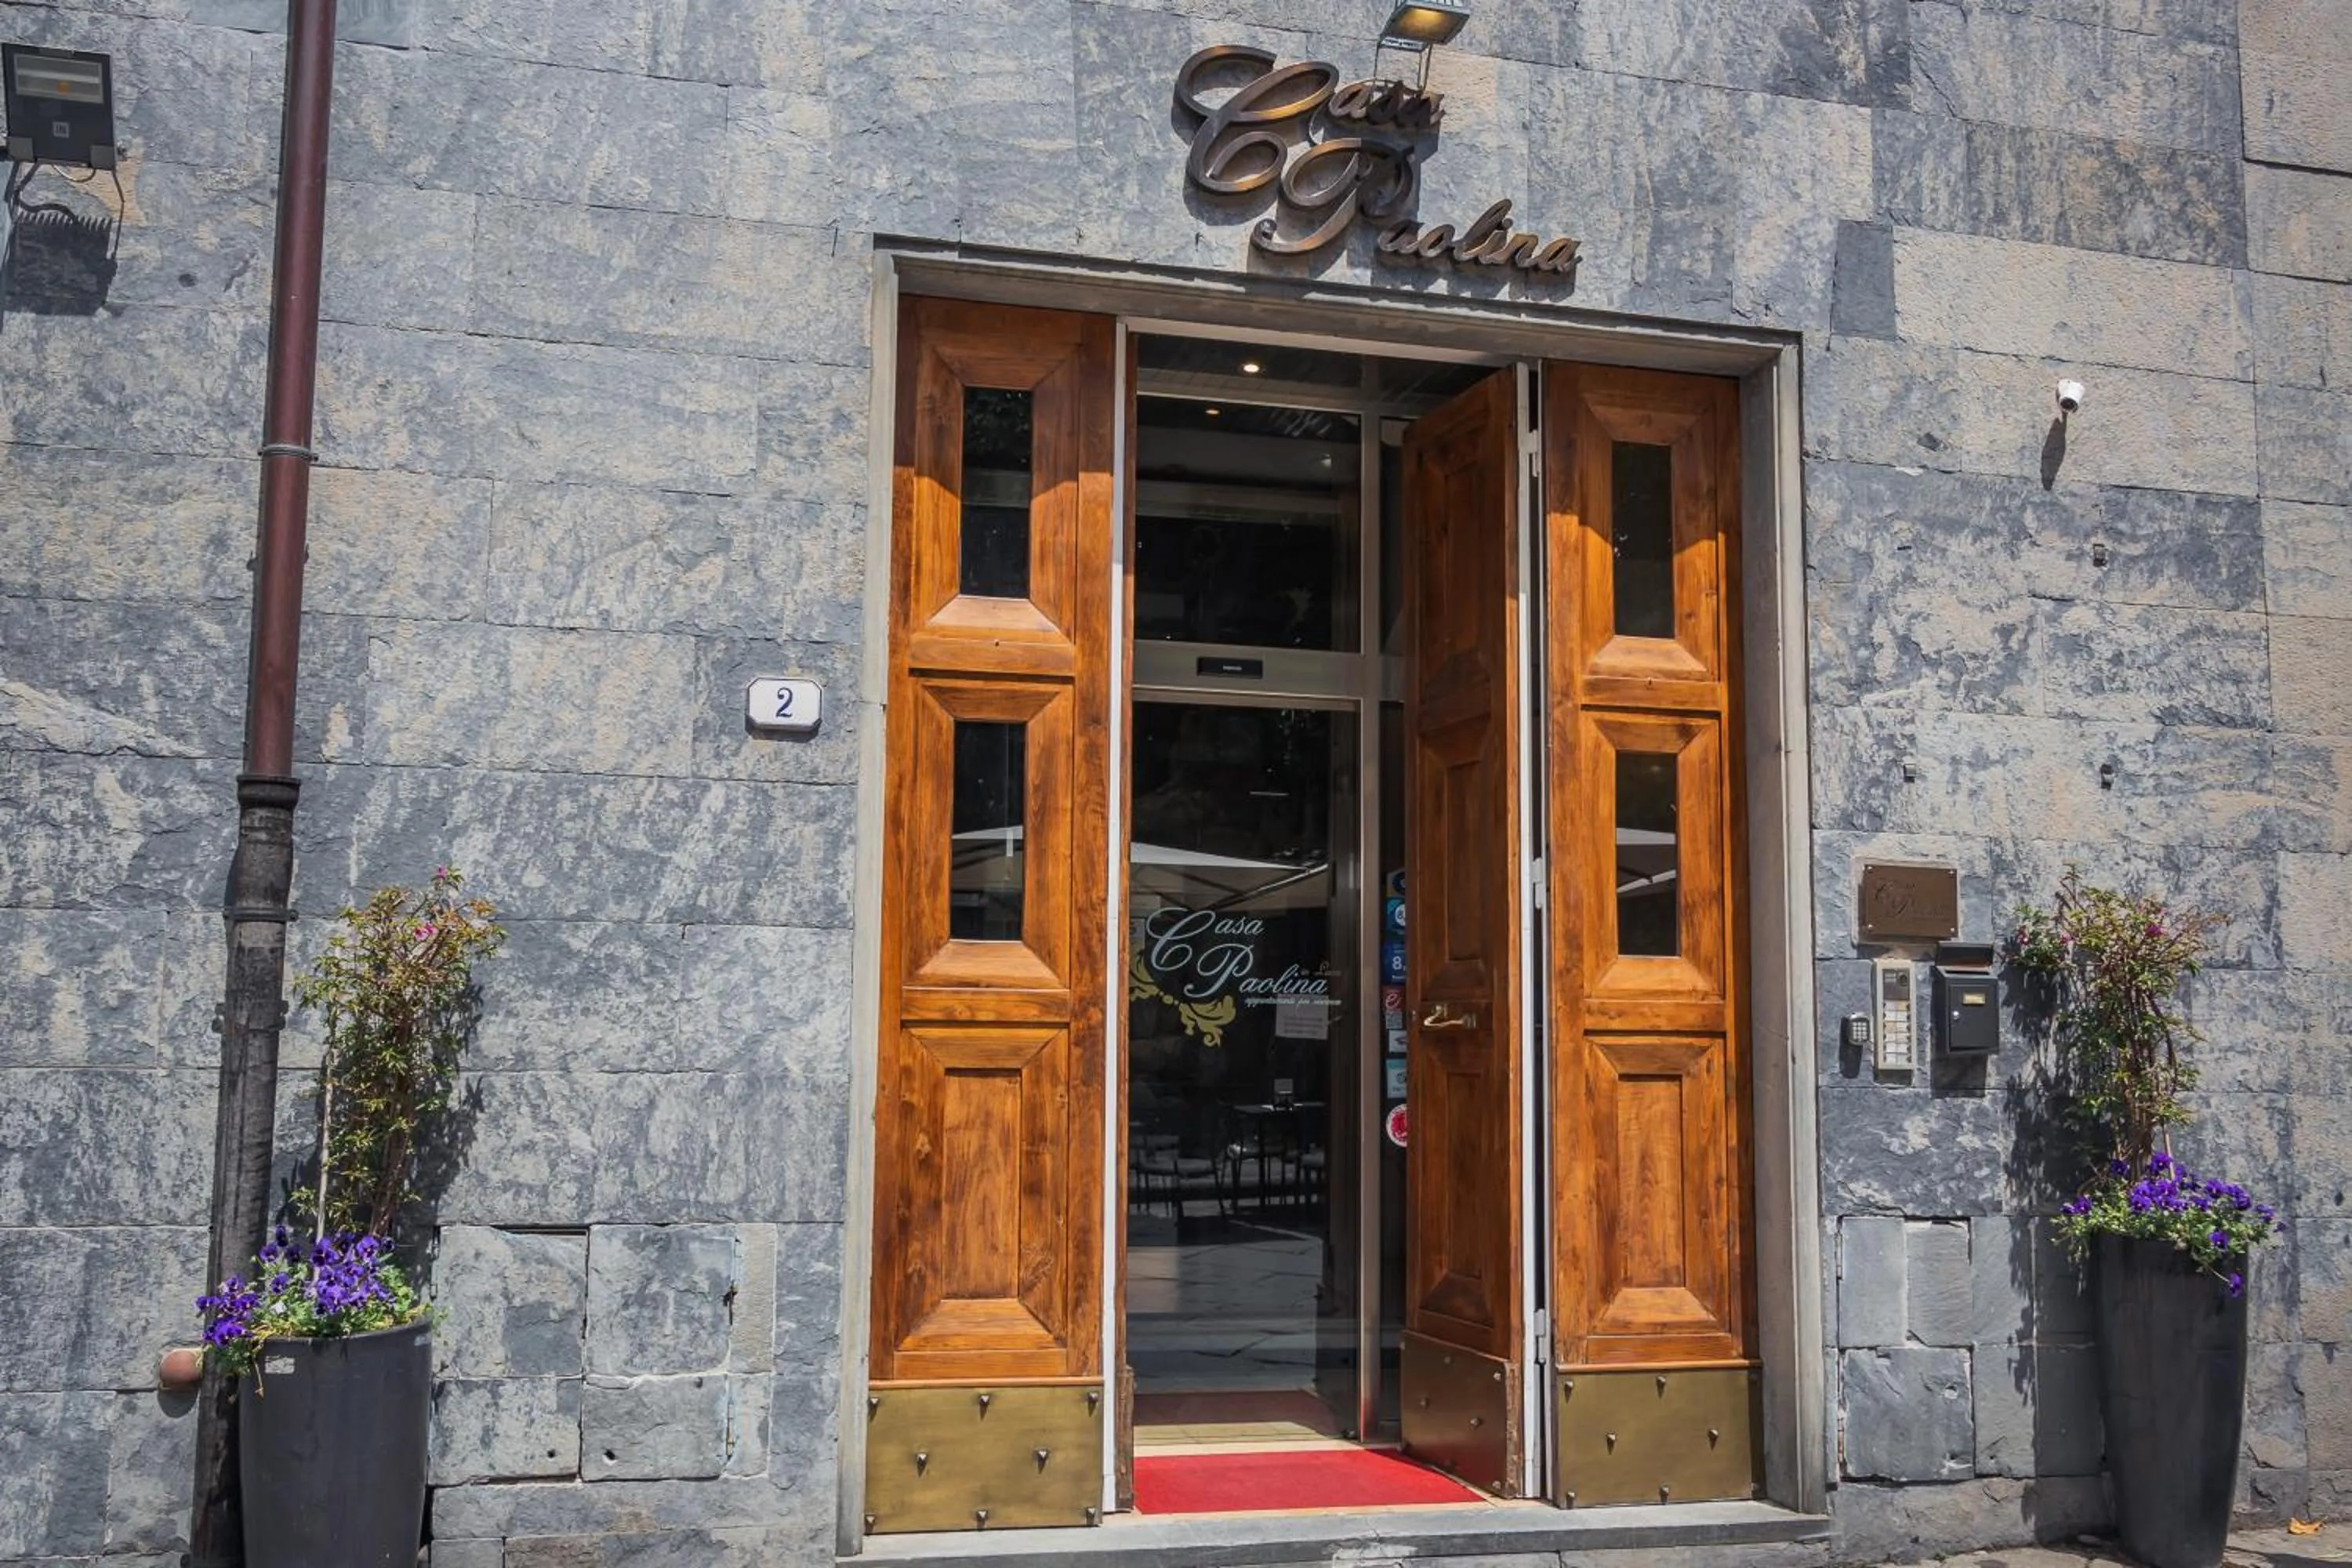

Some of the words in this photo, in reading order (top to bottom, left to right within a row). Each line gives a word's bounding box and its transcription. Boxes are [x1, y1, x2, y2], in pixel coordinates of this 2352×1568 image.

[1179, 45, 1444, 193] Casa
[1252, 138, 1582, 272] Paolina
[775, 687, 793, 718] 2
[1146, 907, 1265, 971] Casa
[1184, 943, 1327, 998] Paolina
